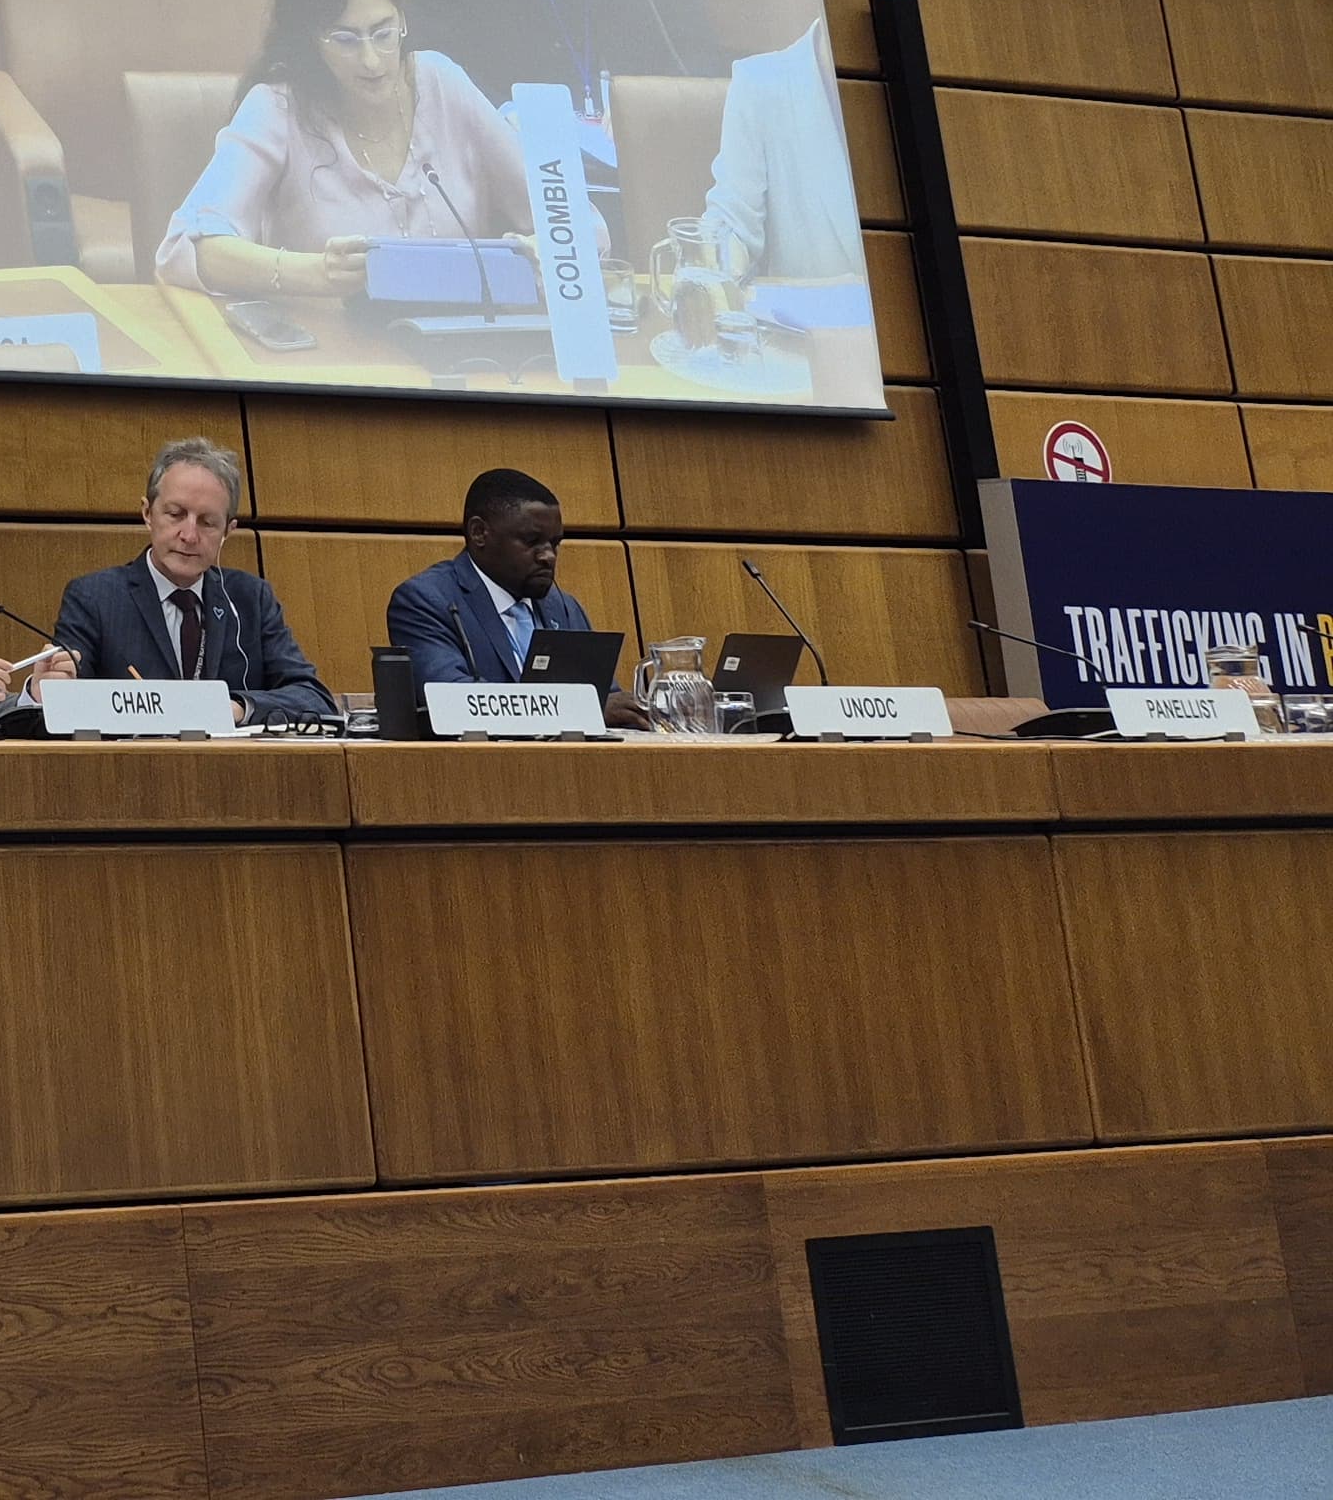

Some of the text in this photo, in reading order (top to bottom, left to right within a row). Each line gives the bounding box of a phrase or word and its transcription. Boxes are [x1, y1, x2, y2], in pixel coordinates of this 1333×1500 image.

[539, 158, 583, 301] COLOMBIA
[1273, 612, 1318, 687] IN
[111, 691, 164, 715] CHAIR
[467, 694, 559, 717] SECRETARY
[840, 697, 898, 719] UNODC
[1146, 699, 1217, 719] PANELLIST
